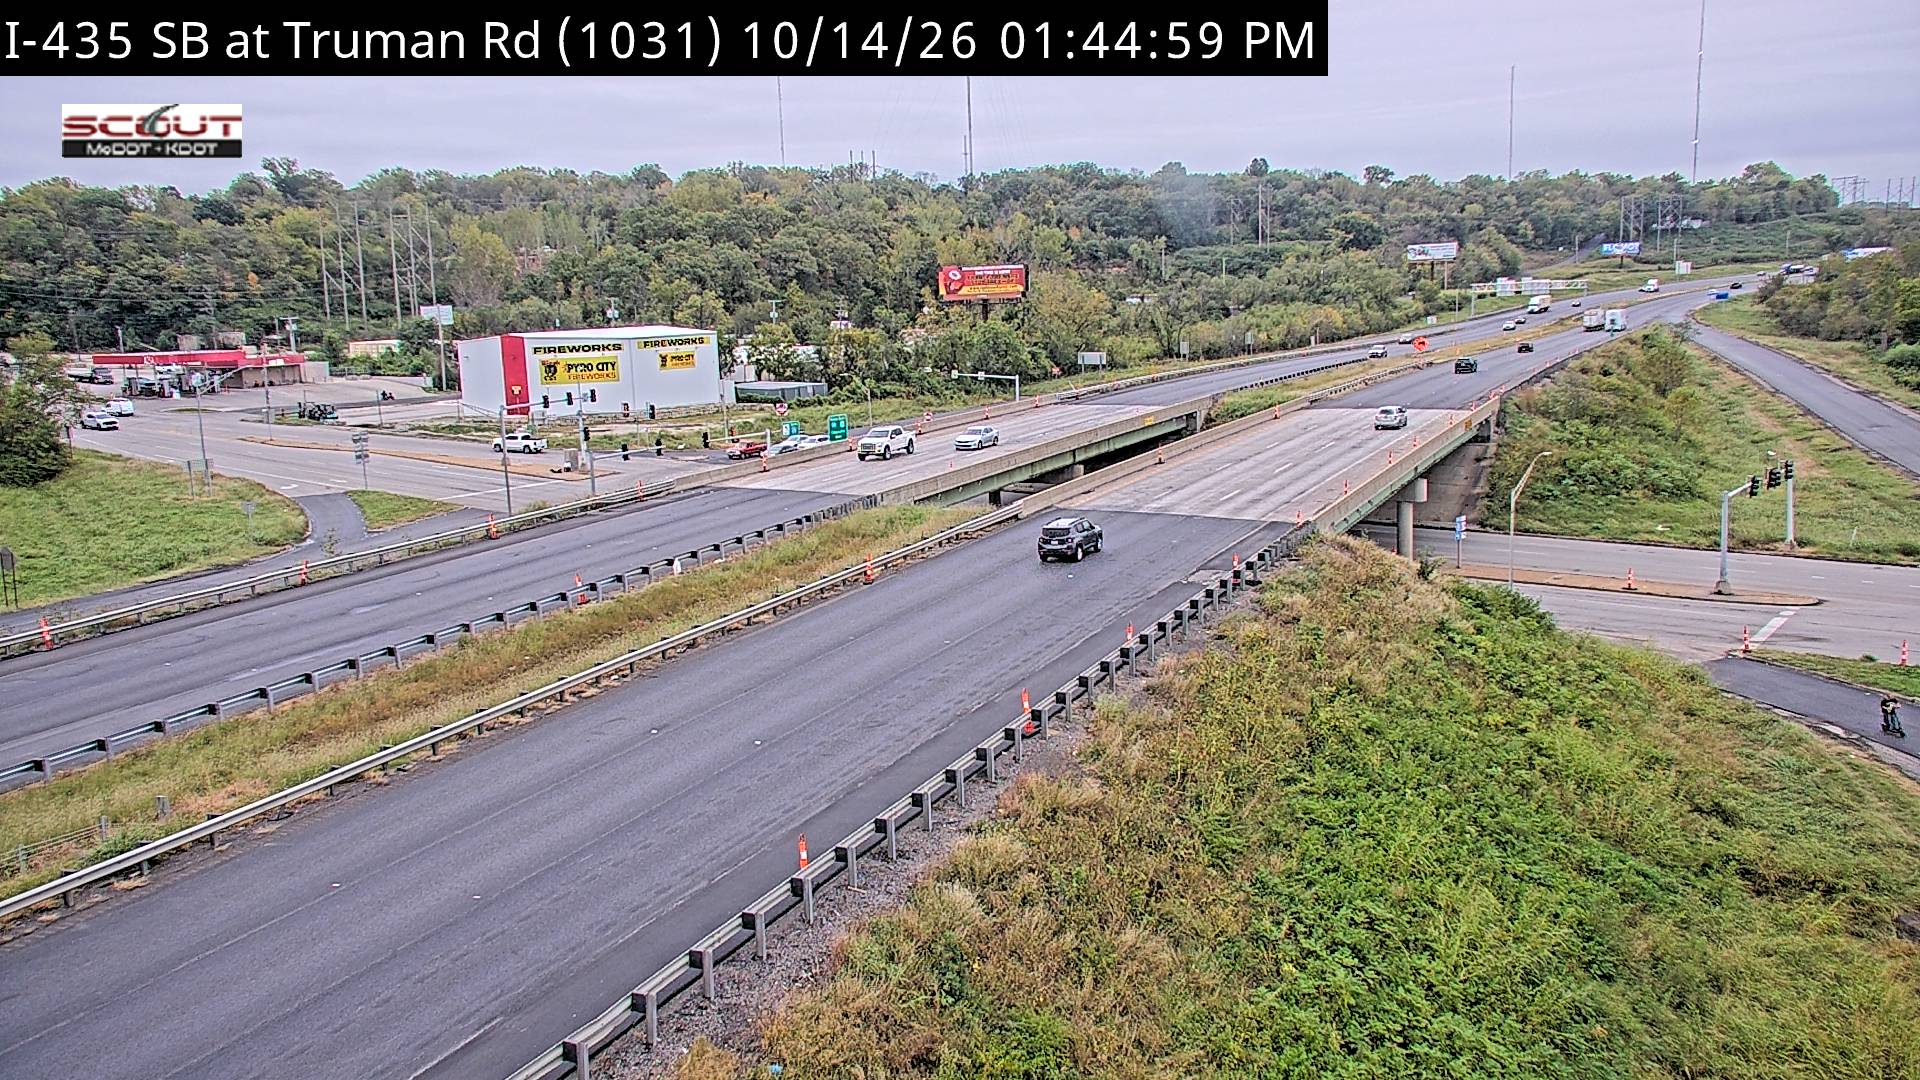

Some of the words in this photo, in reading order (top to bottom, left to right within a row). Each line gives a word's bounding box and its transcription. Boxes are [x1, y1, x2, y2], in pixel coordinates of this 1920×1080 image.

[643, 336, 705, 349] FIREWORKS
[533, 343, 623, 355] FIREWORKS
[566, 362, 594, 373] PYRO
[596, 361, 617, 372] CITY
